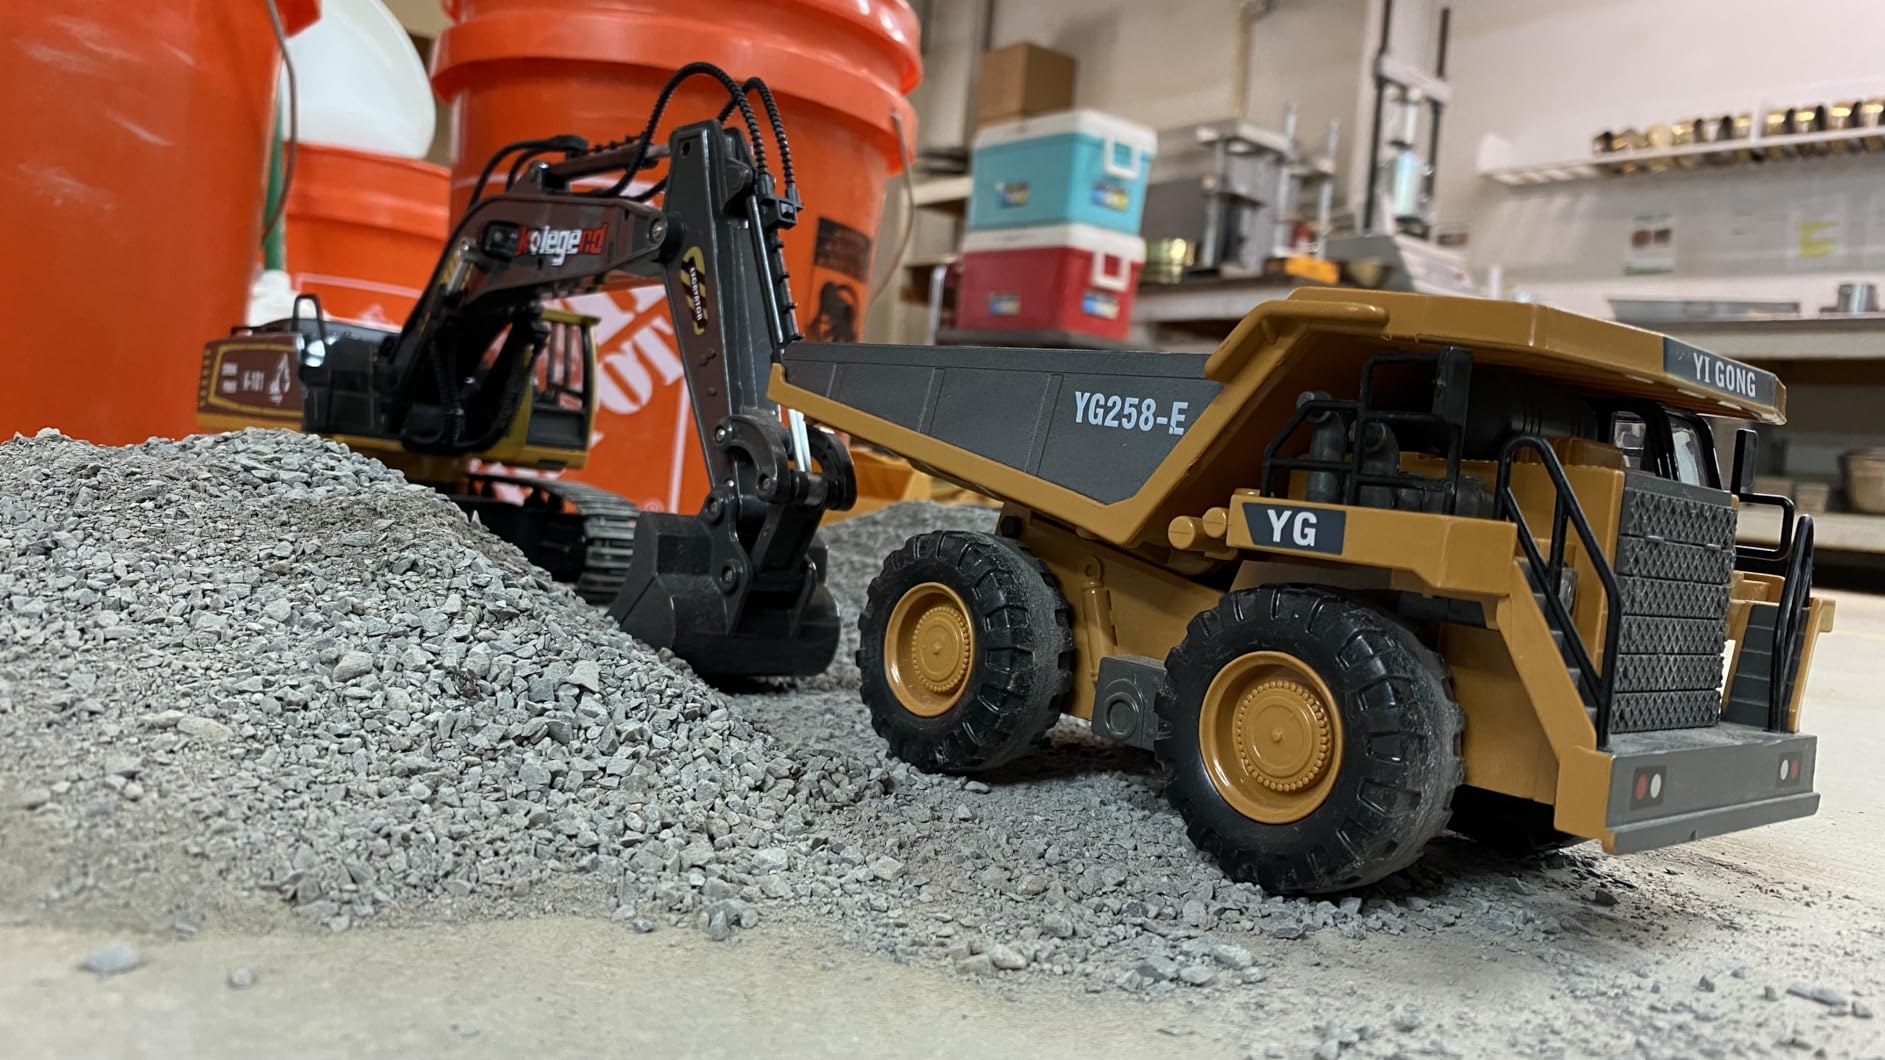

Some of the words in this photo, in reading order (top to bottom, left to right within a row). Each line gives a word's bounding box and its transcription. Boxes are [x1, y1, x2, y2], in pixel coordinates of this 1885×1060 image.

[690, 267, 703, 321] EXCAVATOR
[1693, 352, 1710, 383] YI
[1715, 361, 1756, 398] GONG
[1075, 391, 1189, 435] YG258-E
[1266, 509, 1318, 547] YG
